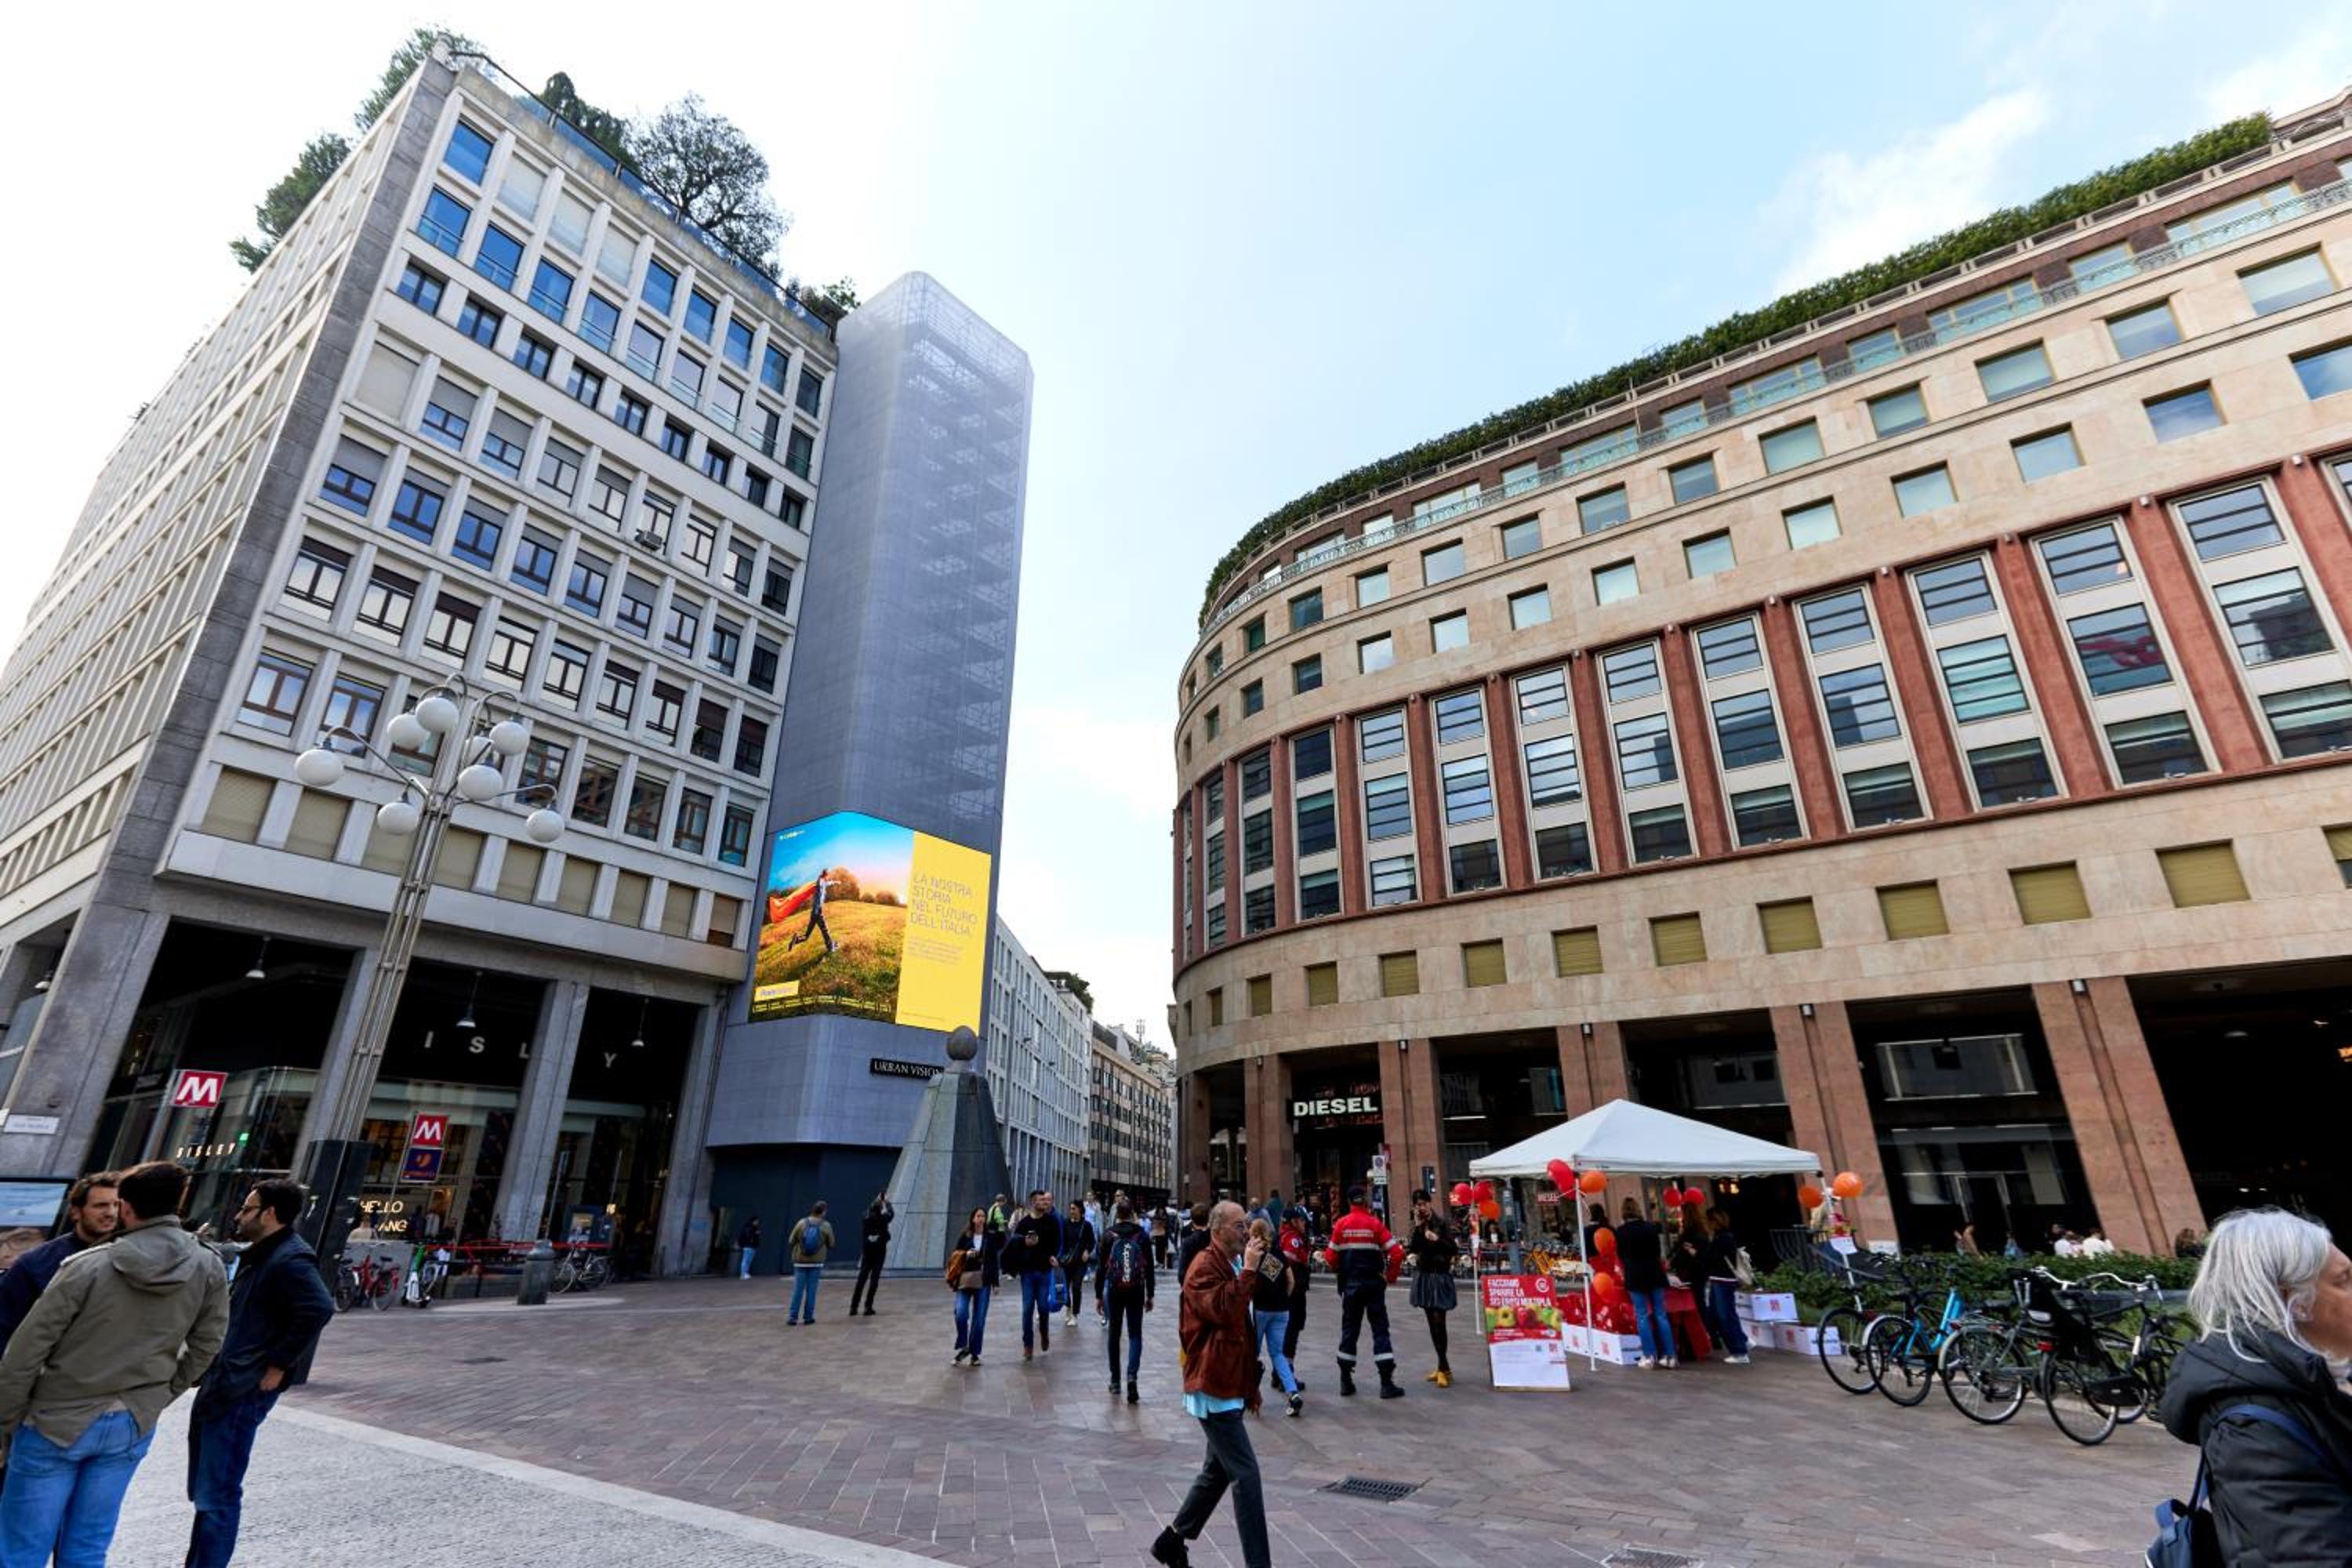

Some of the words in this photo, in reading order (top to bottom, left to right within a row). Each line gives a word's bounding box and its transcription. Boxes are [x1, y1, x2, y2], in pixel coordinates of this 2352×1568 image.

[913, 871, 927, 886] LA
[930, 877, 971, 896] NOSTRA
[913, 886, 951, 904] STORIA
[935, 904, 978, 924] FUTURO
[874, 1060, 909, 1074] URBAN
[176, 1076, 218, 1103] M
[1294, 1098, 1378, 1116] DIESEL
[415, 1120, 441, 1140] M
[176, 1143, 235, 1158] SISLEY
